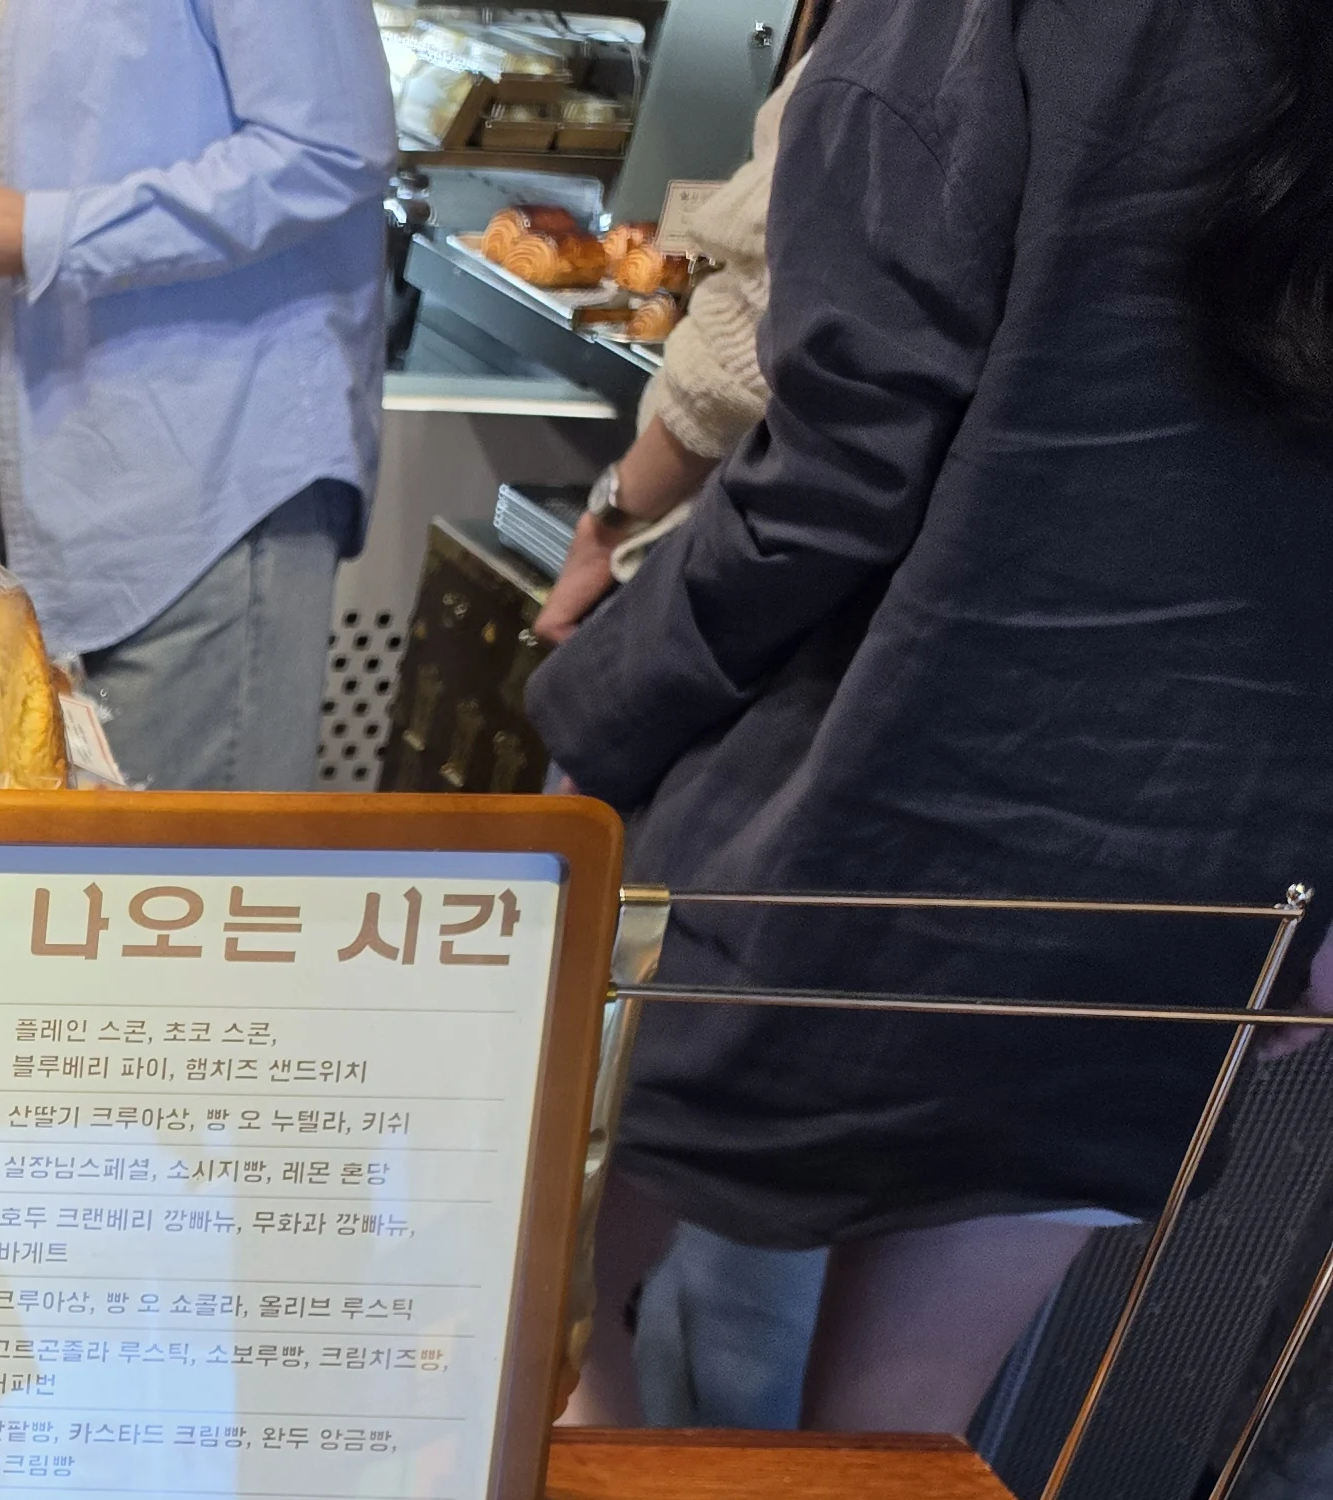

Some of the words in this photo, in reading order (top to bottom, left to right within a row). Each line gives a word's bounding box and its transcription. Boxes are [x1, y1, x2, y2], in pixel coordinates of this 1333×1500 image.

[32, 881, 302, 963] 나오는
[337, 886, 521, 966] 시간
[15, 1018, 87, 1042] 플레인
[98, 1020, 153, 1044] 스콘,
[163, 1022, 211, 1042] 초코
[221, 1022, 277, 1047] 스콘,
[12, 1055, 109, 1079] 블루베리
[120, 1057, 175, 1081] 파이,
[186, 1058, 258, 1081] 햄치즈
[269, 1059, 367, 1083] 샌드위치
[8, 1105, 80, 1128] 산딸기
[90, 1107, 194, 1131] 크루아상,
[206, 1109, 229, 1131] 빵
[237, 1110, 261, 1130] 오
[272, 1110, 351, 1135] 누텔라,
[362, 1111, 410, 1135] 키쉬
[4, 1156, 156, 1182] 실장님스페셜,
[167, 1159, 271, 1184] 소시지빵,
[283, 1161, 331, 1184] 레몬
[340, 1162, 390, 1185] 혼당
[0, 1207, 47, 1229] 호두
[57, 1208, 153, 1231] 크랜베리
[163, 1209, 242, 1234] 깡빠뉴,
[252, 1211, 326, 1235] 무화과
[336, 1213, 416, 1238] 깡빠뉴,
[107, 1292, 129, 1314] 빵
[137, 1293, 160, 1313] 오
[170, 1293, 248, 1319] 쇼콜라,
[259, 1295, 331, 1318] 올리브
[341, 1297, 413, 1321] 루스틱
[118, 1340, 195, 1366] 루스틱,
[206, 1344, 309, 1369] 소보루빵,
[319, 1347, 449, 1373] 크림치즈빵,
[69, 1422, 163, 1445] 카스타드
[173, 1425, 251, 1449] 크림빵,
[262, 1427, 309, 1450] 완두
[321, 1428, 397, 1454] 앙금빵,
